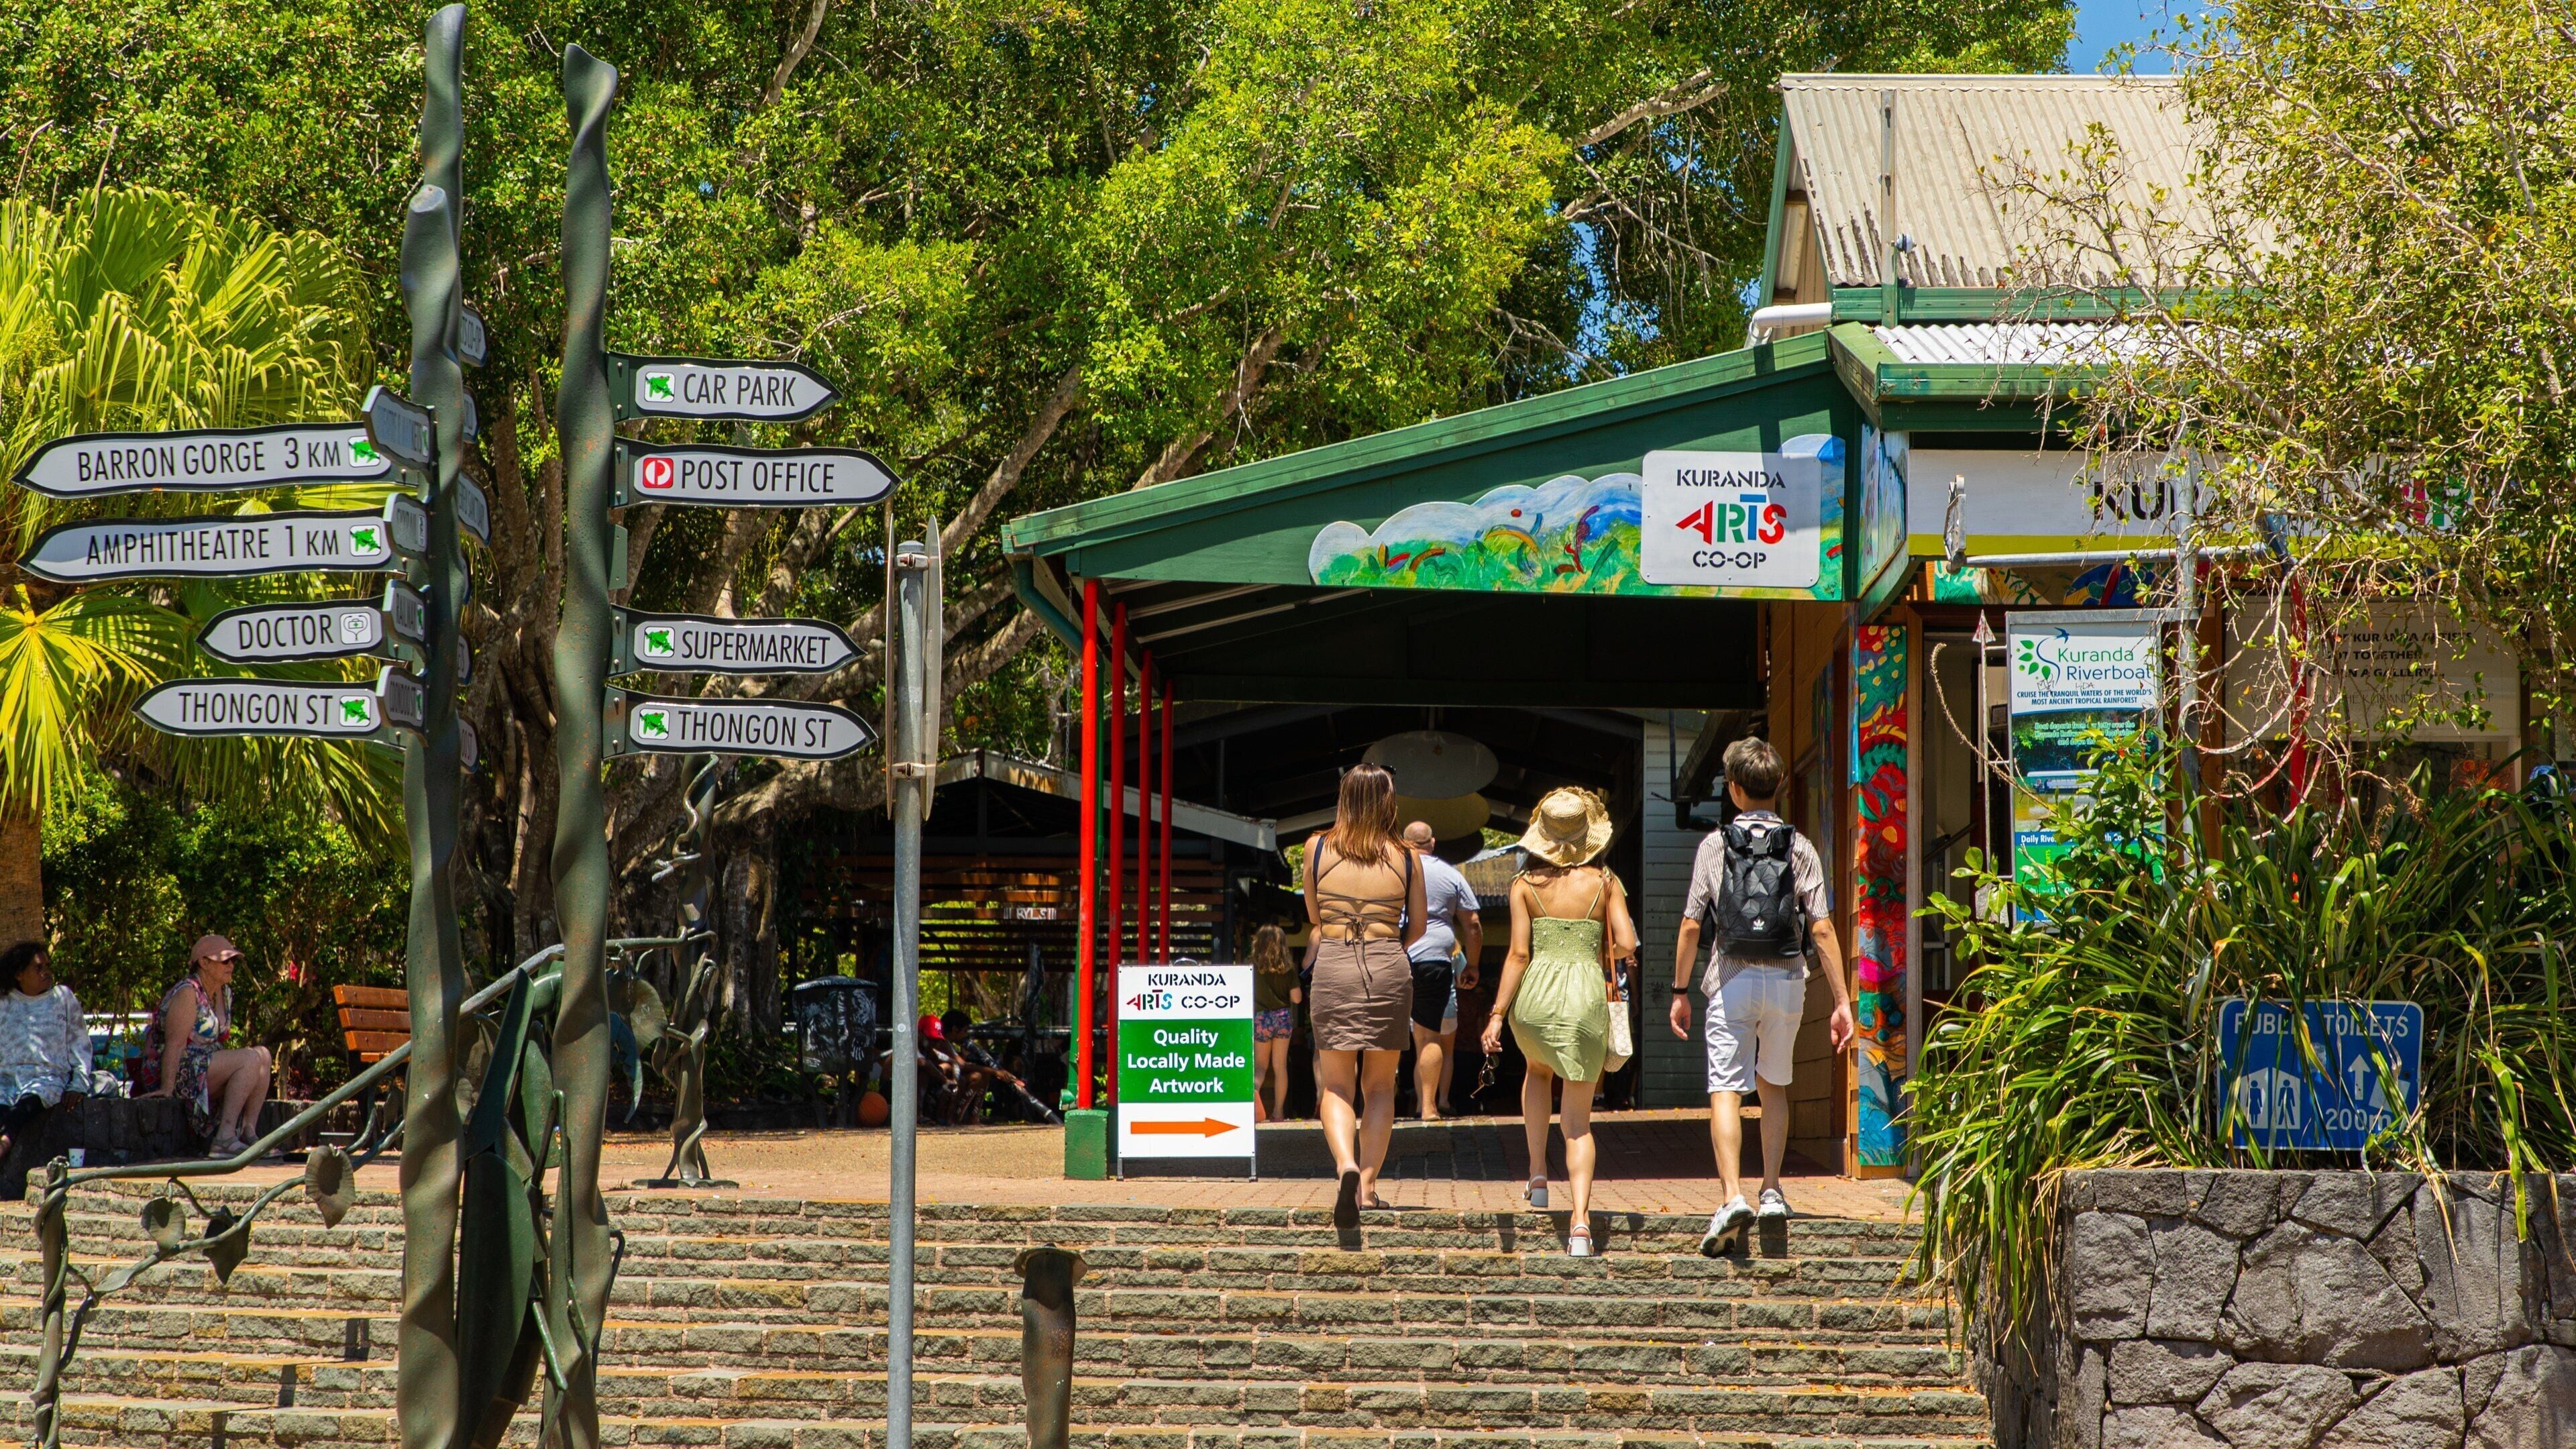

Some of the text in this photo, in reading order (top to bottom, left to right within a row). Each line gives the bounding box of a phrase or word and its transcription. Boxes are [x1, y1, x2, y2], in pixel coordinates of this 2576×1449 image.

[683, 372, 796, 407] CAR PARK
[77, 437, 341, 482] BARRON GORGE 3 KM
[681, 458, 835, 494] POST OFFICE
[1676, 468, 1786, 489] KURANDA
[1674, 493, 1788, 545] ARTS
[86, 525, 339, 566] AMPHITHEATRE 1 KM
[1692, 550, 1767, 569] CO-OP
[238, 614, 335, 651] DOCTOR
[681, 630, 830, 665] SUPERMARKET
[2057, 646, 2134, 663] Kuranda
[2066, 663, 2151, 681] Riverboat
[178, 692, 334, 725] THONGON ST
[678, 710, 832, 749] THONGON ST
[2035, 722, 2049, 730] Boat
[2057, 738, 2070, 746] and
[2021, 835, 2039, 845] Daily
[1148, 973, 1227, 986] KURANDA
[1126, 989, 1241, 1011] ARTS CO-OP
[2234, 1012, 2409, 1038] PUBLI TOILETS
[1153, 1028, 1219, 1048] Quality
[1127, 1051, 1246, 1072] Locally Made
[1148, 1077, 1224, 1093] Artwork
